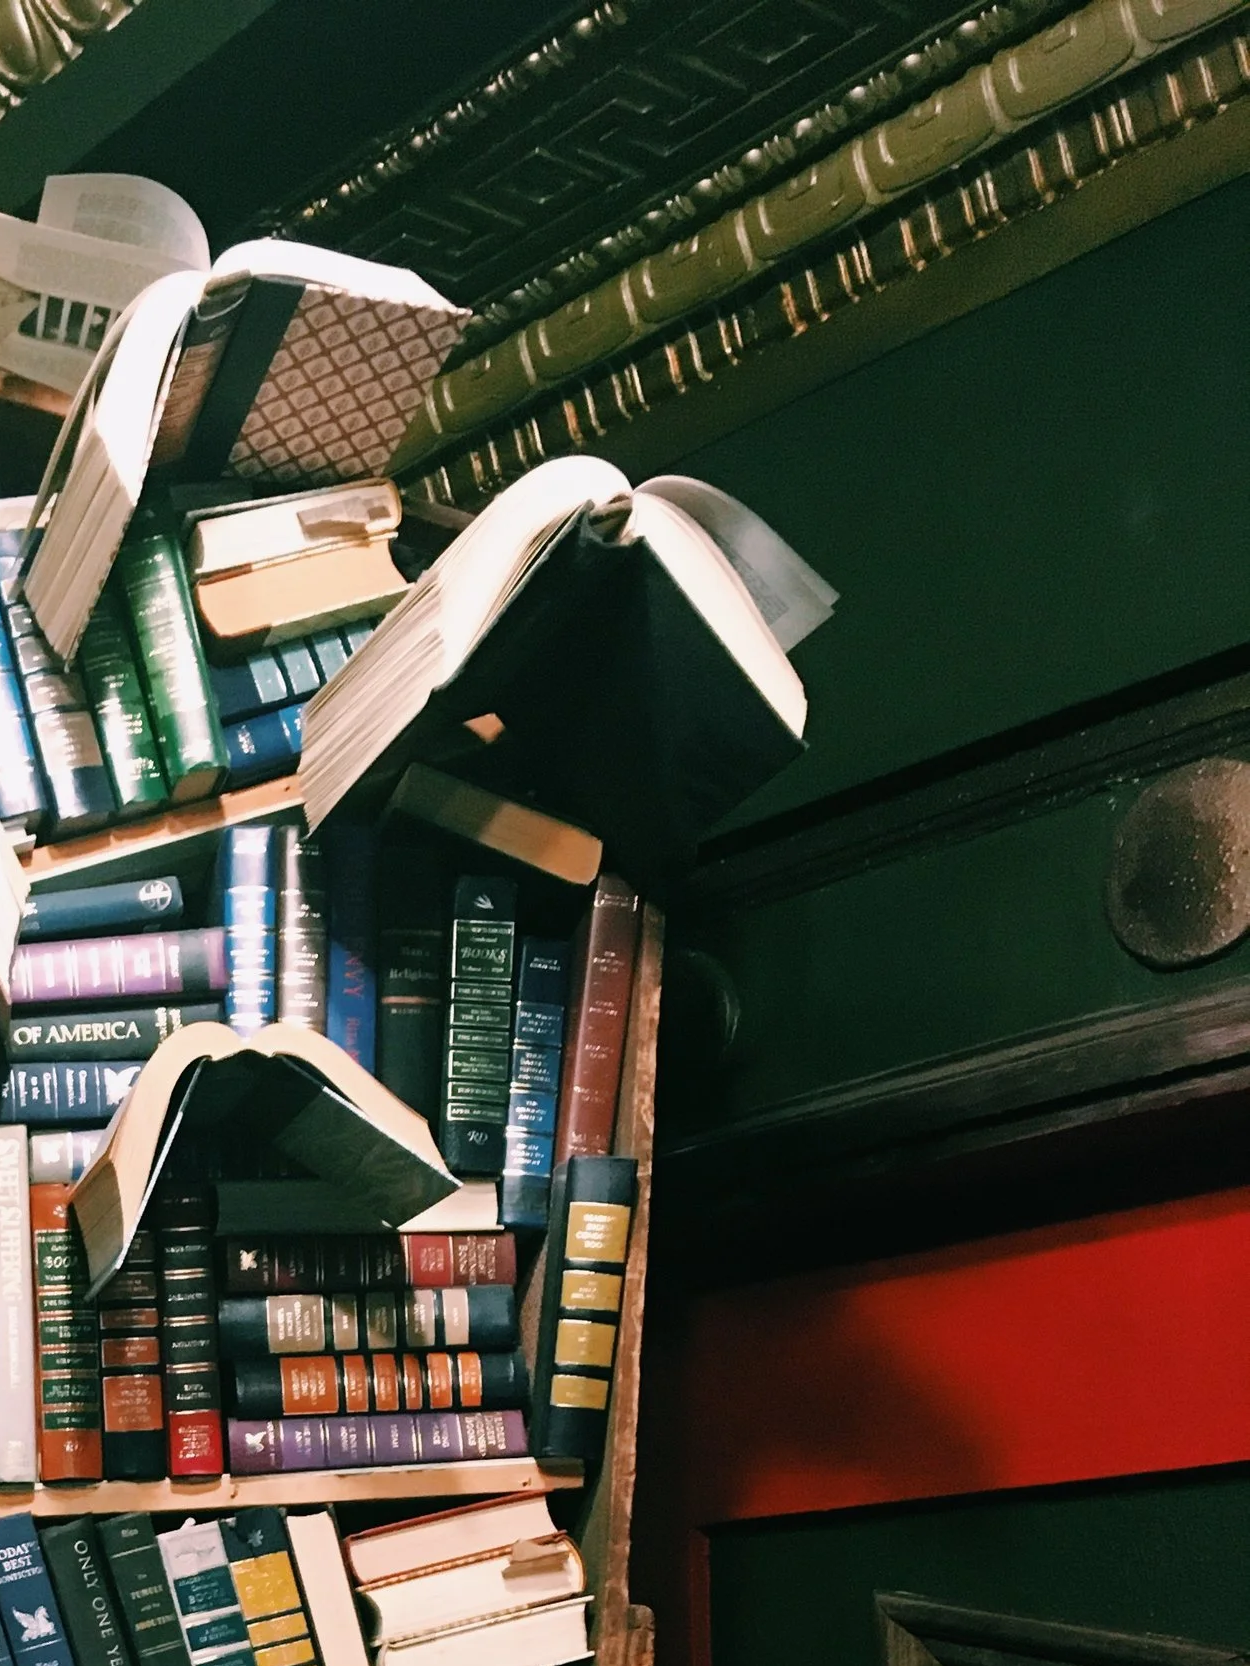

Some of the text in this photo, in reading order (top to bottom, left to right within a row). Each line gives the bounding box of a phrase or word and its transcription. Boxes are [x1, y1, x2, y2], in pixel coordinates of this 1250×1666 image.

[460, 946, 507, 964] BOOKS
[13, 1026, 42, 1045] OF
[46, 1021, 141, 1044] AMERICA
[2, 1555, 32, 1572] BEST
[74, 1540, 99, 1589] ONLY
[92, 1596, 116, 1639] ONE
